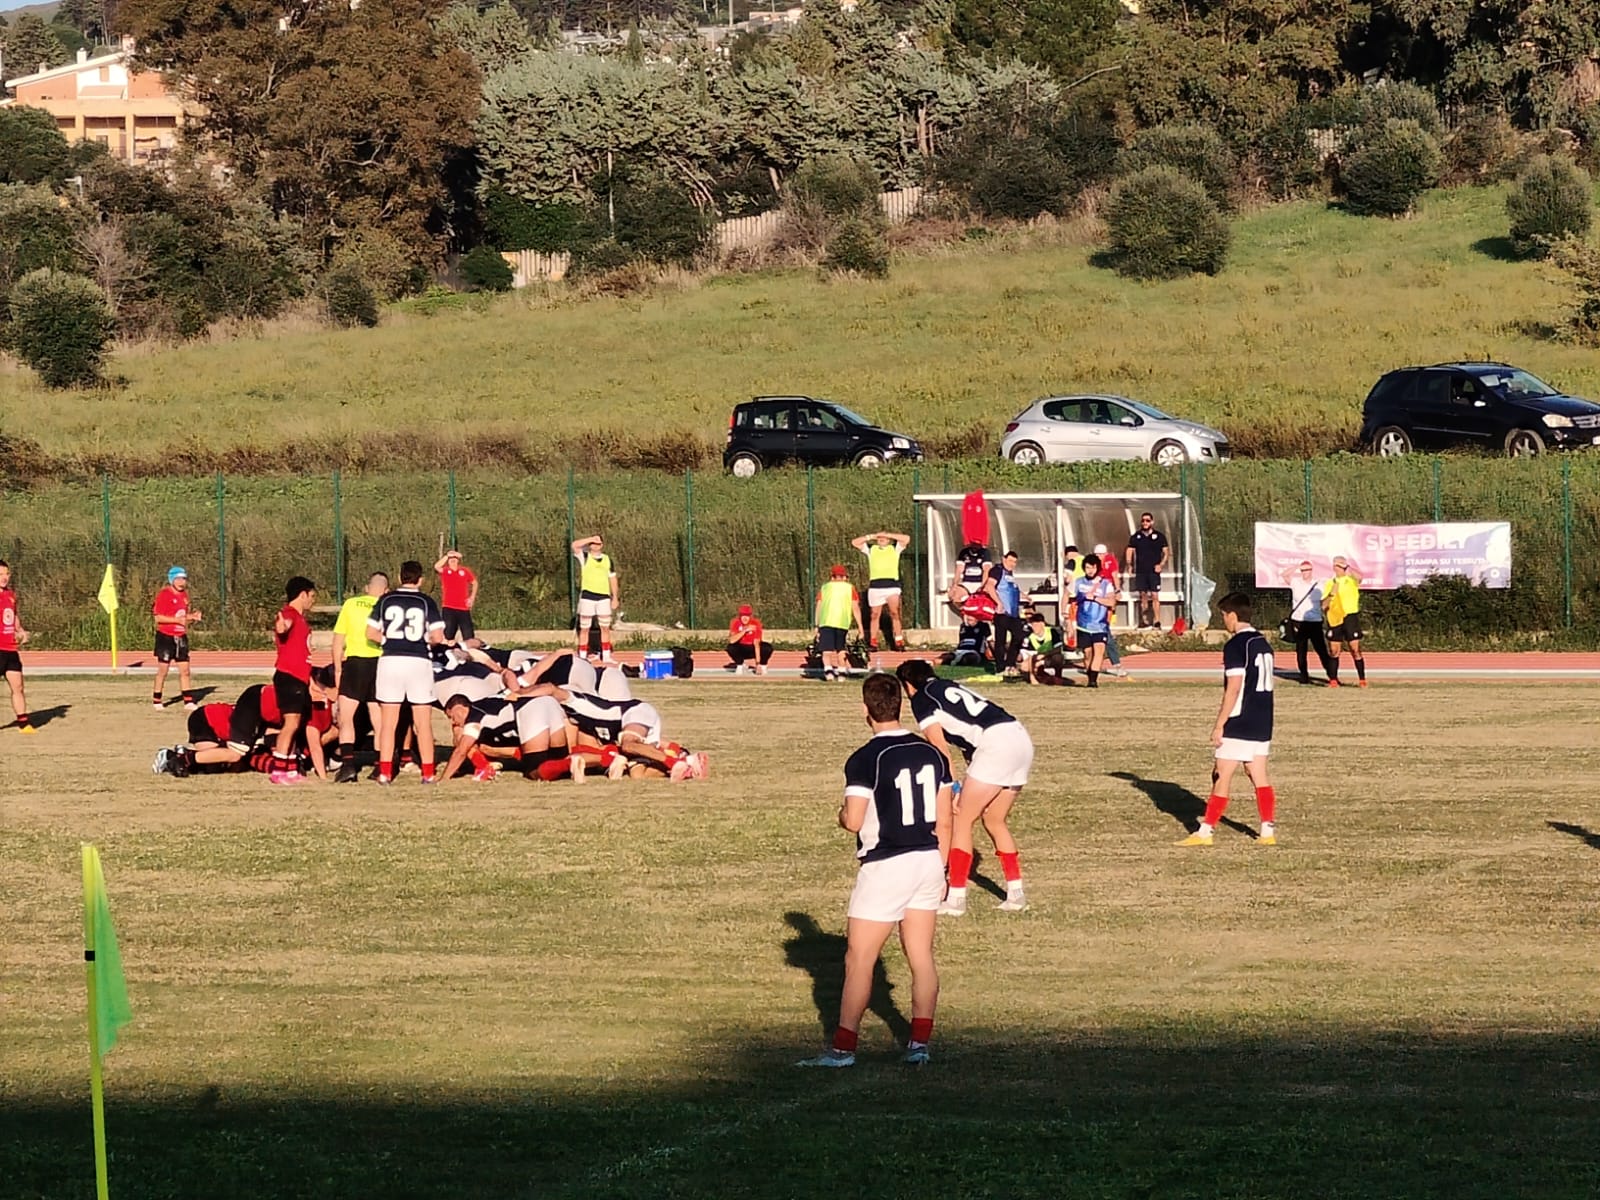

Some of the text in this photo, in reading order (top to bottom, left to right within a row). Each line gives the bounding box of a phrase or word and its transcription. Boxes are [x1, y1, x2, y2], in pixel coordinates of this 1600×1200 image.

[1405, 558, 1438, 566] STAMPA
[384, 605, 425, 642] 23
[1254, 652, 1274, 692] 10
[944, 684, 989, 717] 2
[894, 764, 937, 826] 11
